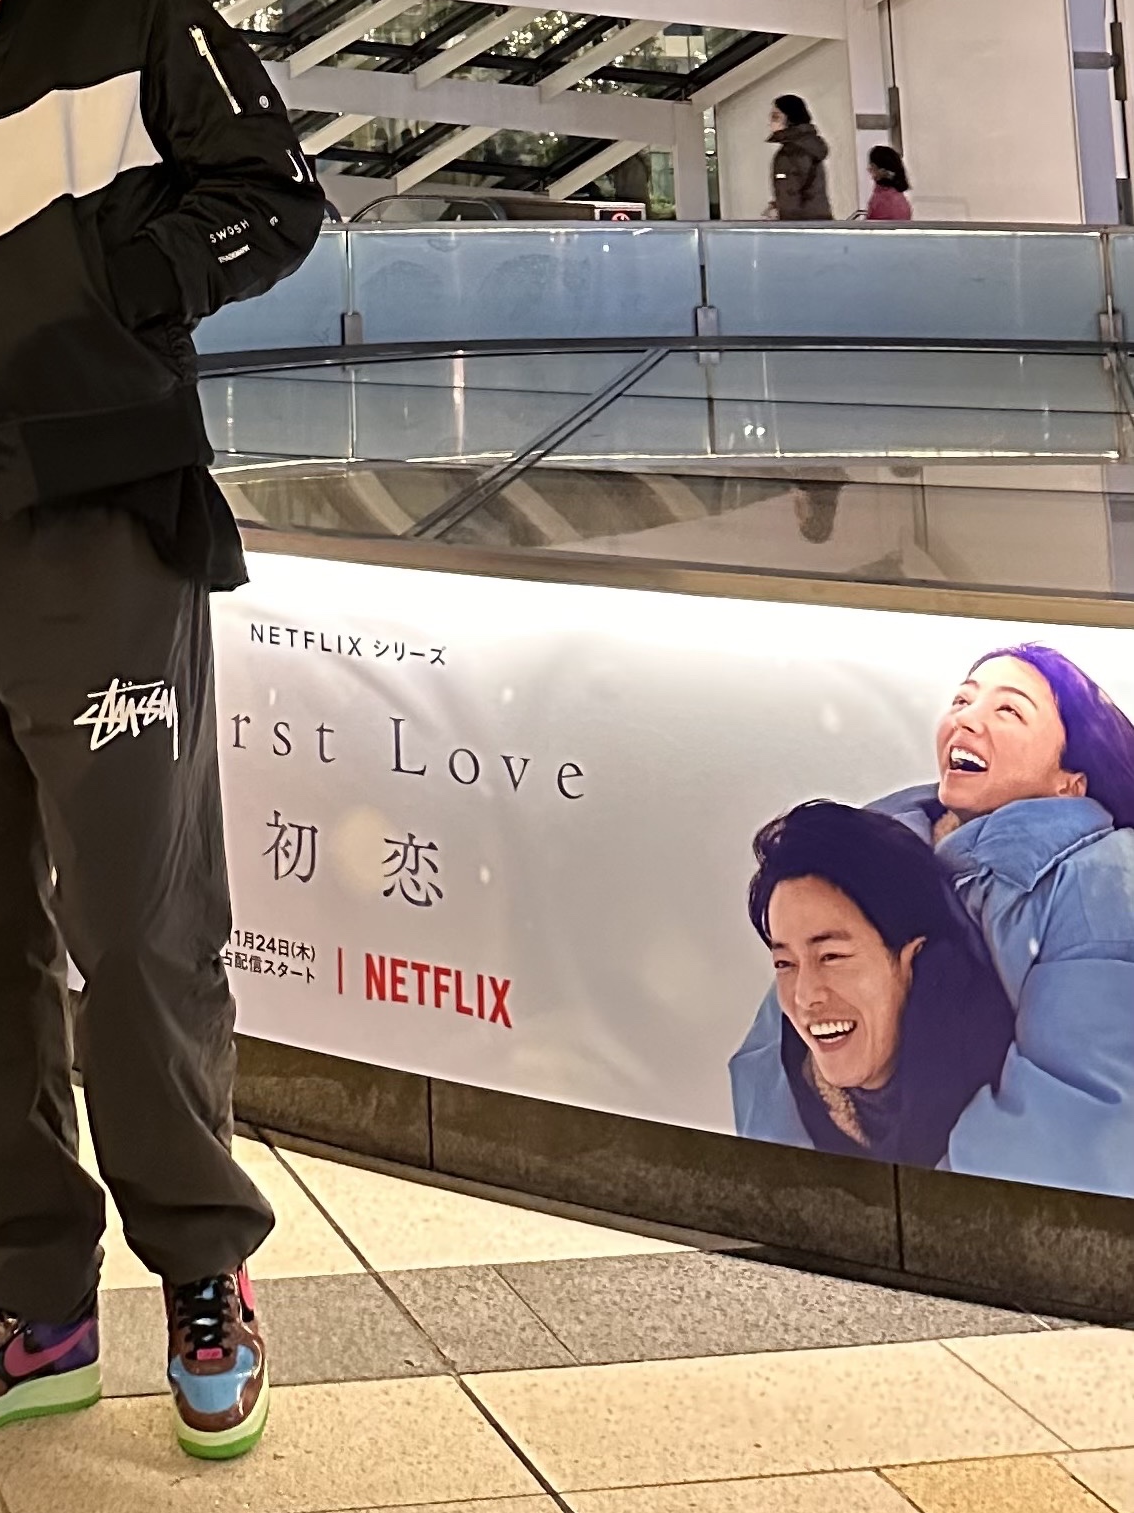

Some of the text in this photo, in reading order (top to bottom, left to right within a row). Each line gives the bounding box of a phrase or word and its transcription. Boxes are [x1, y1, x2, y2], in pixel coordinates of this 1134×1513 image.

[250, 623, 447, 666] NETFLIX シリーズ
[231, 712, 585, 800] rst Love
[263, 810, 444, 907] 初恋
[223, 948, 315, 984] 占配信スタート
[365, 953, 513, 1029] NETFLIX
